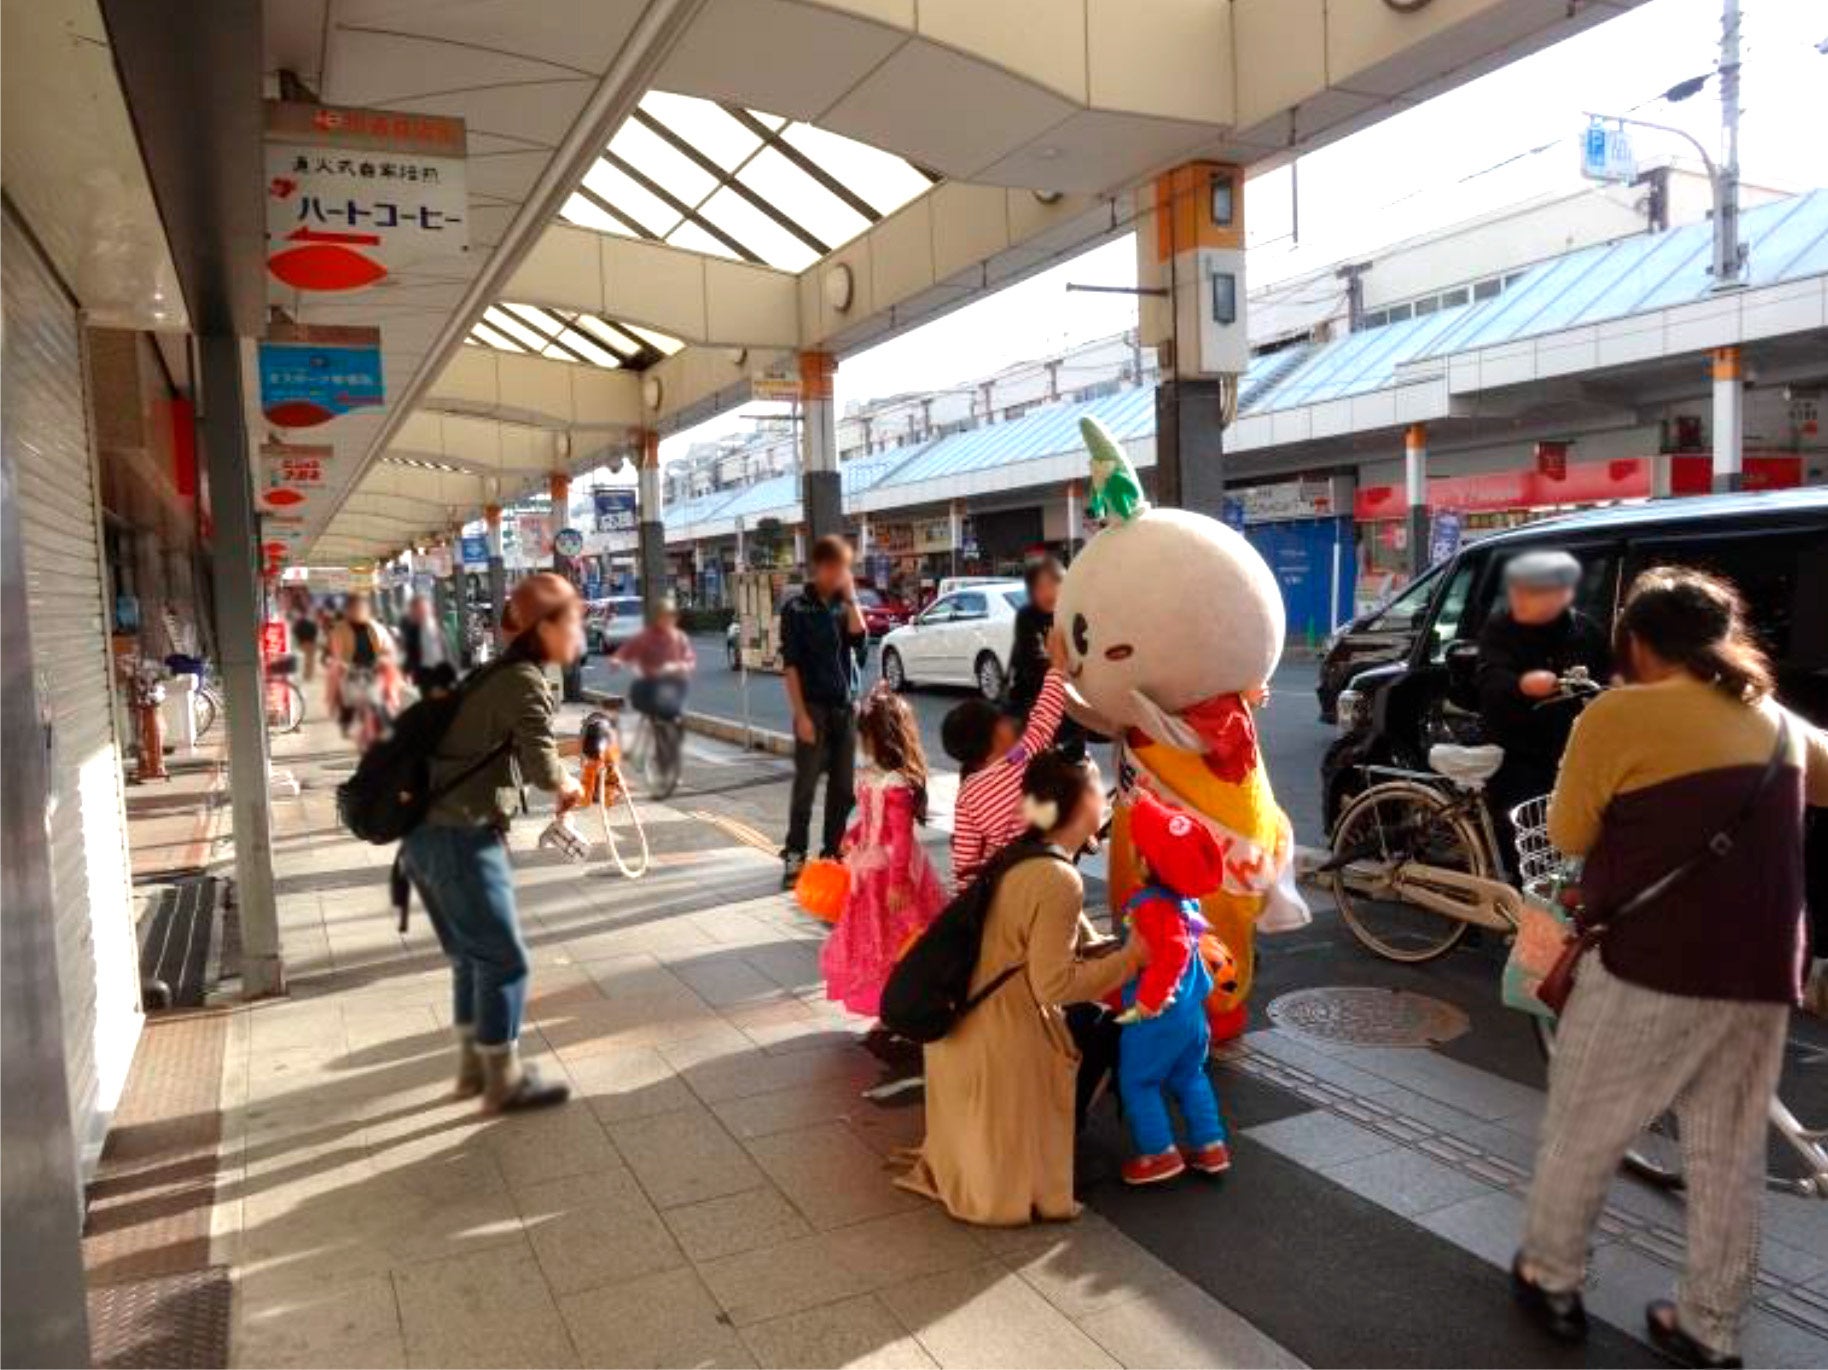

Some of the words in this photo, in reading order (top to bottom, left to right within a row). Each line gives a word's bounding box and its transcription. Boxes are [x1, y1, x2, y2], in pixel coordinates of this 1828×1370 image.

[298, 197, 461, 230] ハートコーヒー
